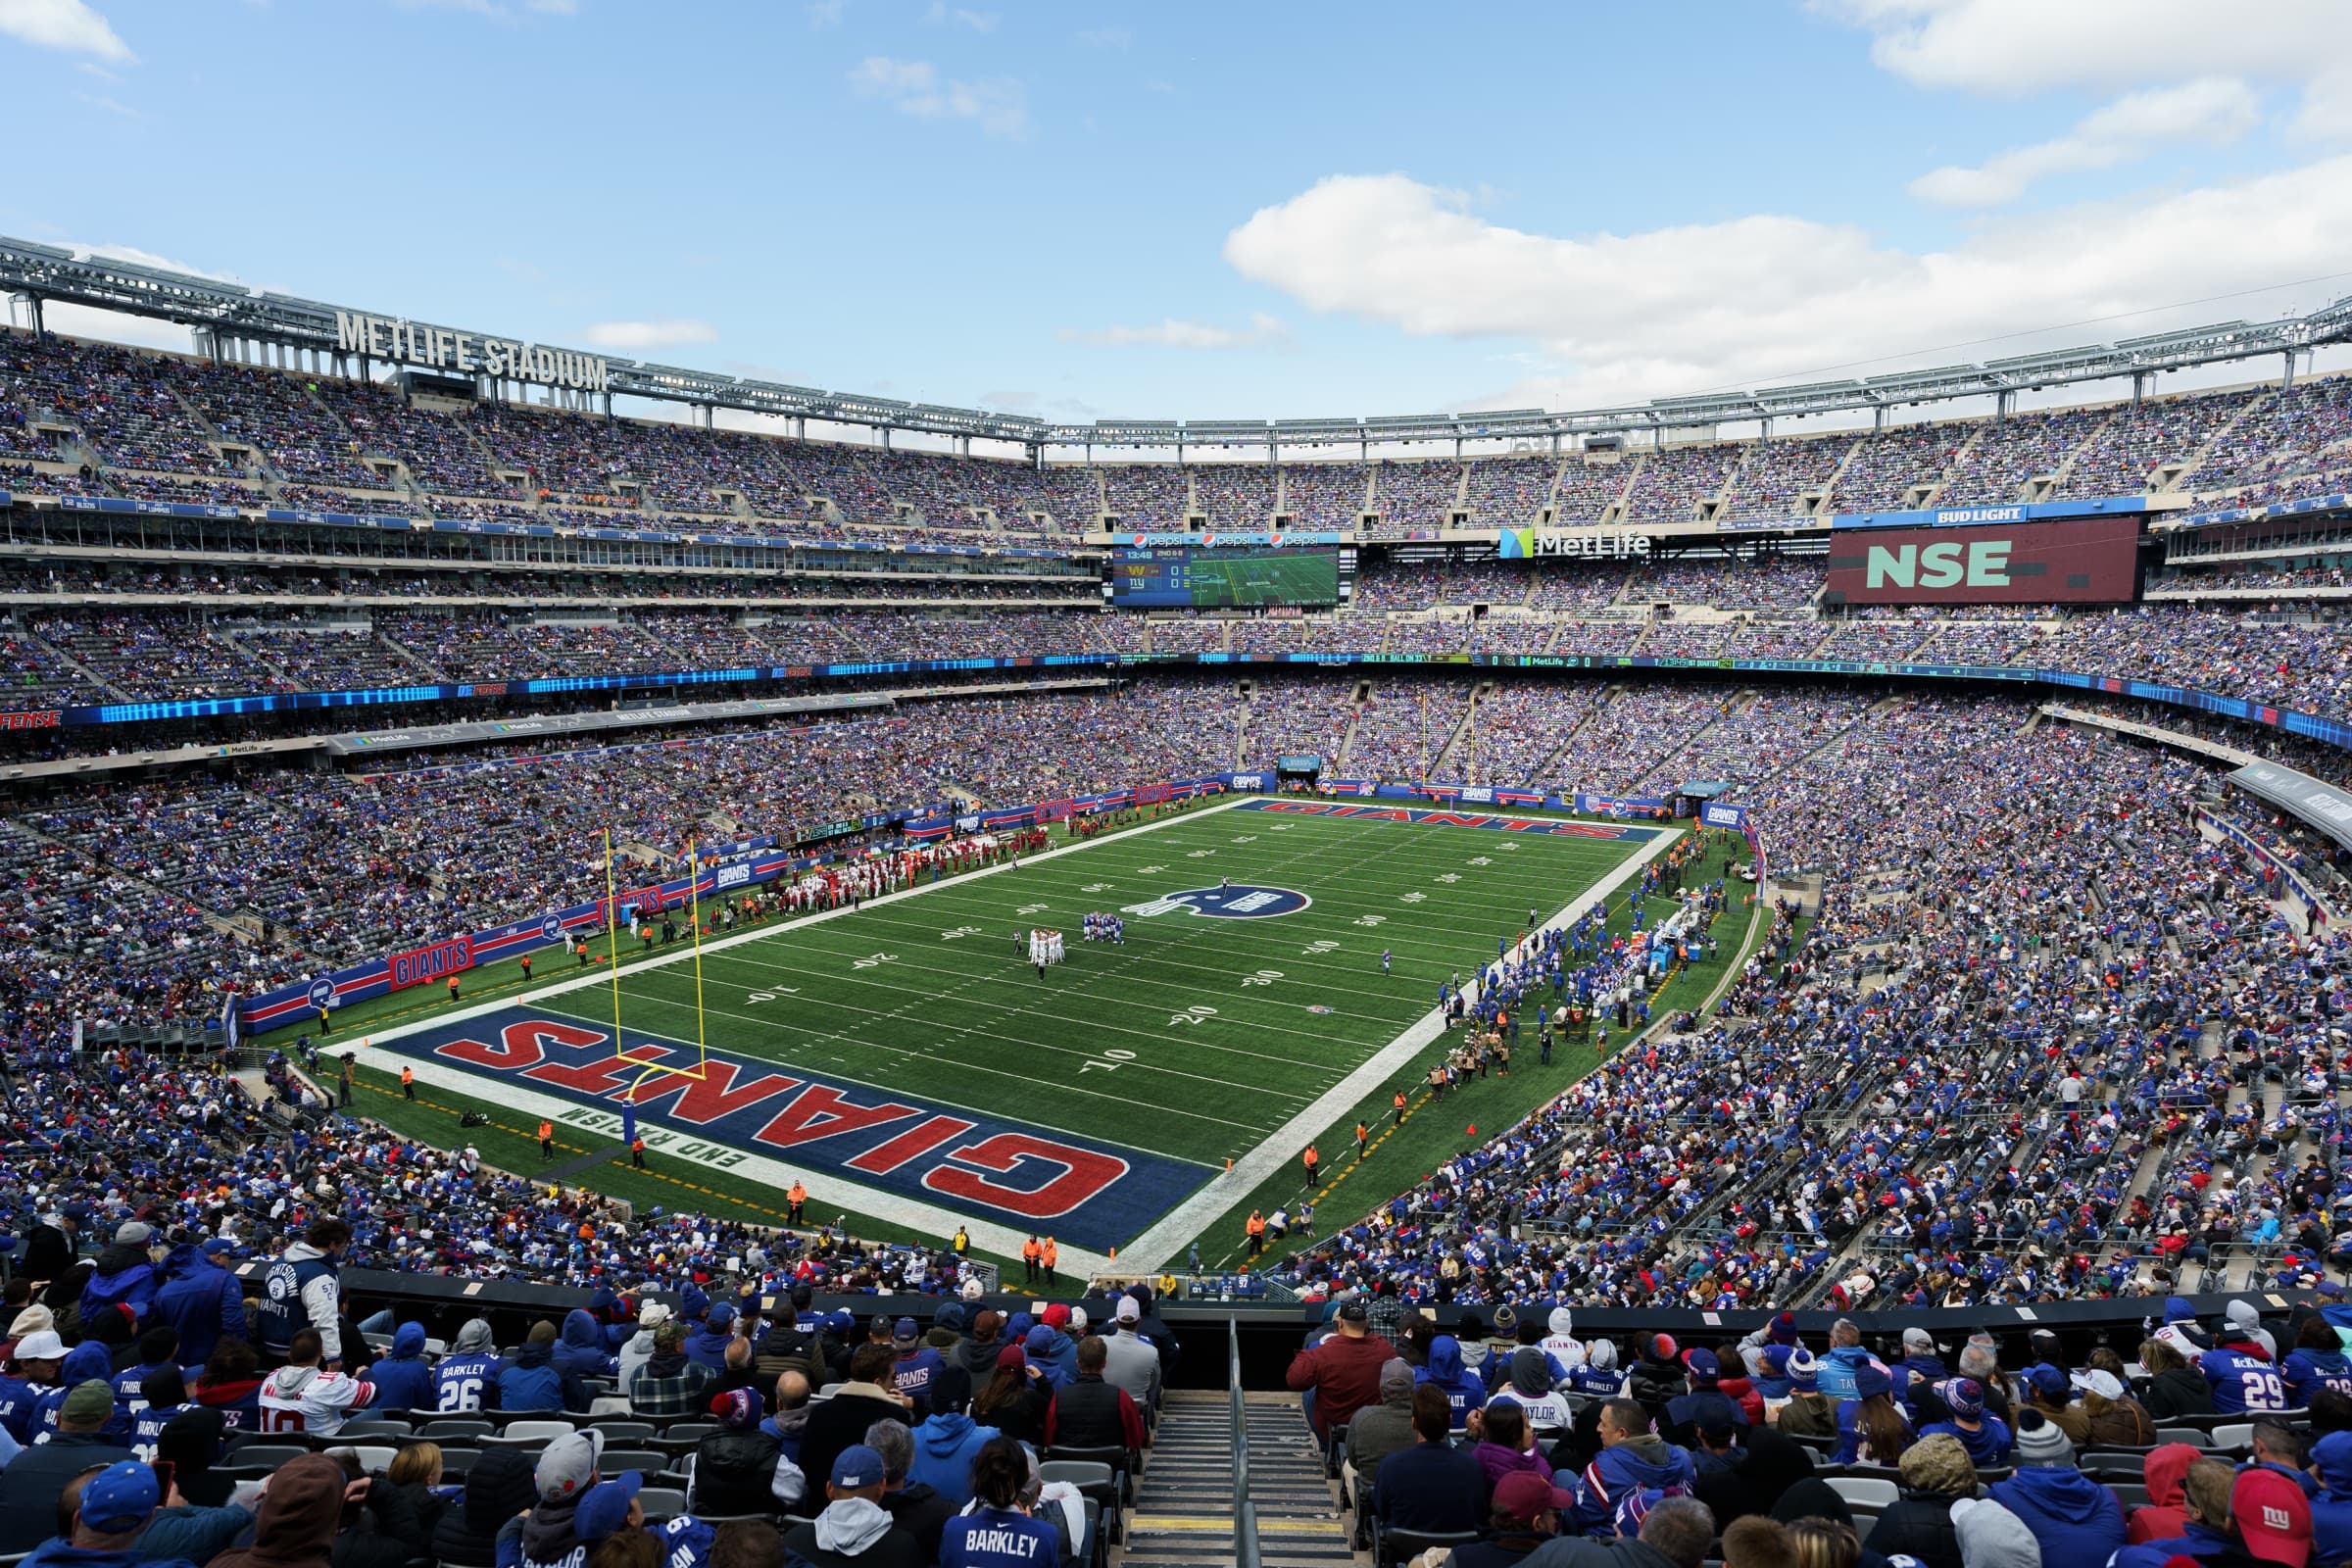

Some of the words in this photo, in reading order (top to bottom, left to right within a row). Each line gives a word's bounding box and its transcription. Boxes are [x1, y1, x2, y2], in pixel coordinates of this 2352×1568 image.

[335, 311, 475, 370] METLIFE
[484, 339, 608, 392] STADIUM
[1936, 508, 1981, 525] BUD
[1984, 505, 2023, 522] LIGHT
[1149, 535, 1183, 548] pepsi
[1217, 535, 1250, 548] pepsi
[1285, 534, 1318, 547] pepsi
[1539, 529, 1651, 557] MetLife
[1170, 565, 1179, 576] 0
[1866, 540, 2012, 589] NSE
[1170, 578, 1179, 589] 0
[0, 710, 63, 730] FENSE
[616, 710, 656, 722] METLIFE
[657, 708, 692, 719] STADIUM
[509, 722, 543, 731] MetLife
[370, 734, 411, 744] MetLife
[231, 745, 258, 754] MetLife
[1233, 775, 1262, 788] GIANTS
[1462, 788, 1493, 801] GIANTS
[1260, 803, 1628, 839] GIANTS
[1708, 807, 1740, 824] GIANTS
[717, 863, 751, 884] GIANTS
[395, 941, 469, 986] GIANTS
[853, 952, 900, 968] 20
[1242, 970, 1285, 986] 30
[748, 984, 801, 1003] 10
[1171, 1005, 1218, 1025] 20
[1084, 1049, 1138, 1072] 10
[433, 1019, 1129, 1218] GIANTS
[557, 1107, 677, 1148] RACISM
[677, 1142, 749, 1168] END
[1547, 1340, 1579, 1349] GIANTS
[442, 1363, 486, 1379] BARKLEY
[438, 1379, 483, 1412] 26
[1586, 1380, 1614, 1392] BARKLEY
[2241, 1371, 2284, 1409] 29
[2262, 1504, 2290, 1531] ny
[965, 1529, 1039, 1559] BARKLEY
